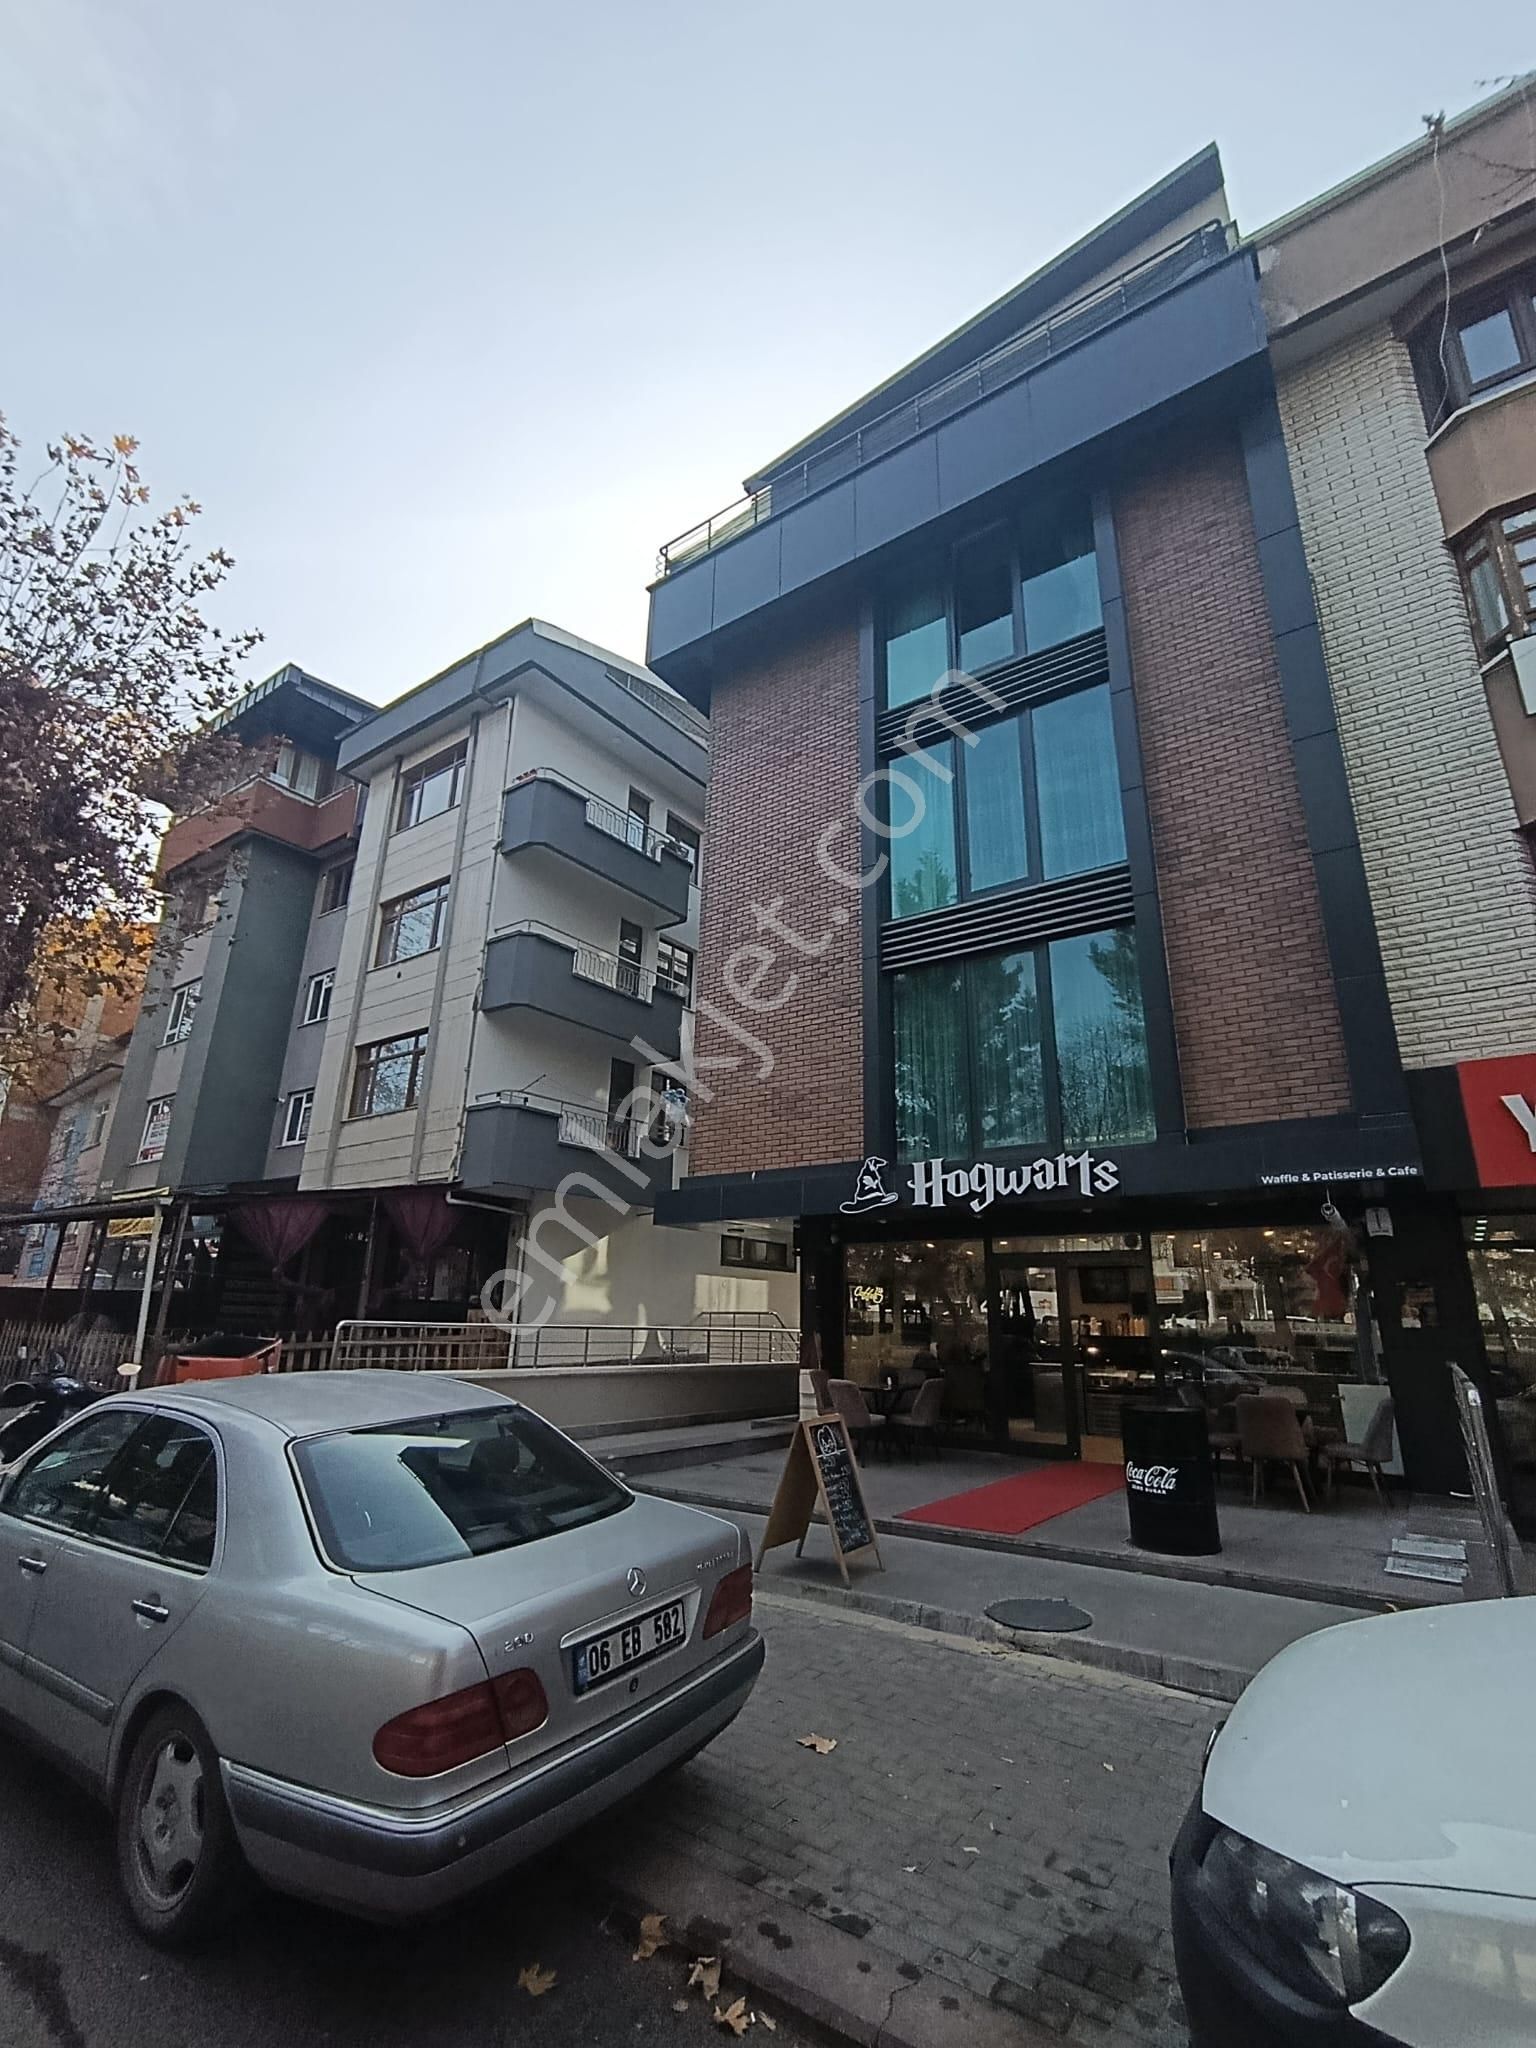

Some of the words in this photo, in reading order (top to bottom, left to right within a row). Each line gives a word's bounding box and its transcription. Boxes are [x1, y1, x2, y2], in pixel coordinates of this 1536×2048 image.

[907, 1150, 1120, 1213] Hogwarts
[1261, 1173, 1299, 1185] Waffle
[1301, 1172, 1311, 1183] &
[1313, 1168, 1373, 1181] Patisserie
[1375, 1167, 1386, 1178] &
[1388, 1165, 1418, 1177] Cafe
[1126, 1460, 1180, 1490] Coca-Cola
[589, 1640, 611, 1677] 06
[621, 1626, 642, 1662] EB
[653, 1607, 682, 1645] 582
